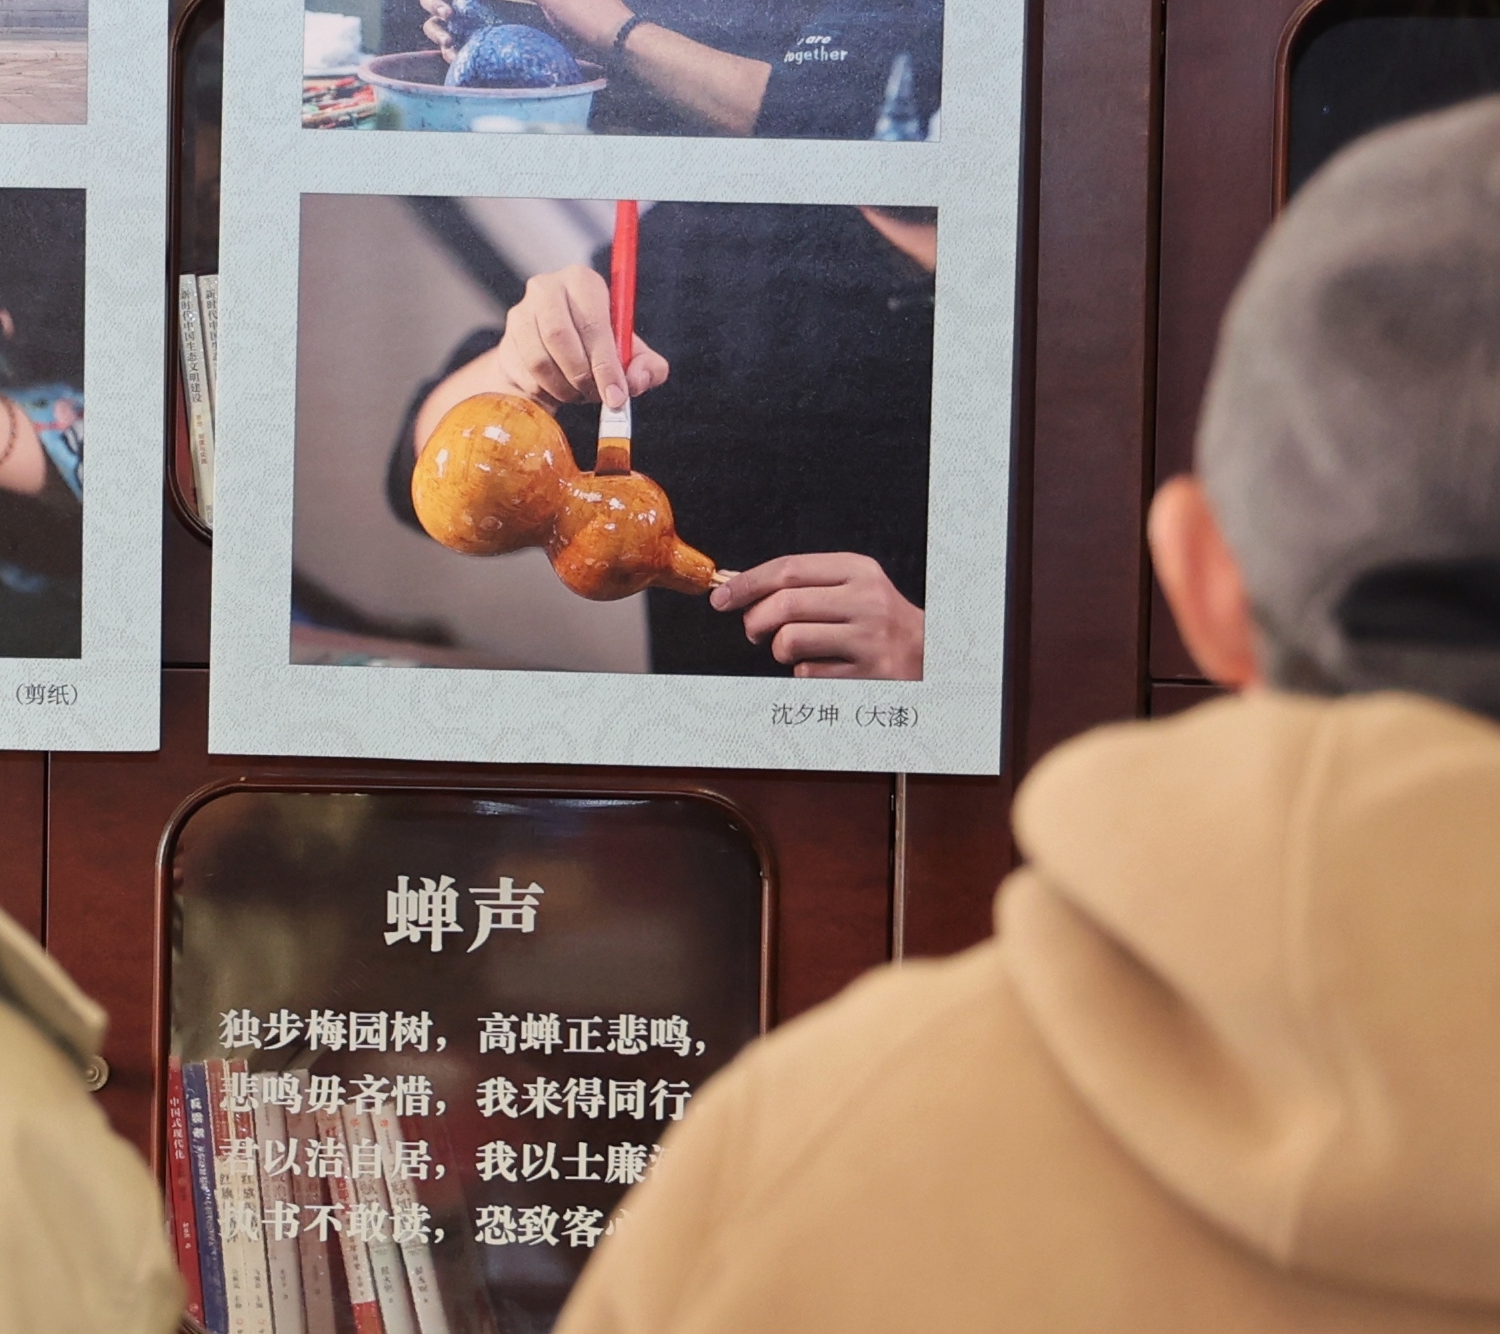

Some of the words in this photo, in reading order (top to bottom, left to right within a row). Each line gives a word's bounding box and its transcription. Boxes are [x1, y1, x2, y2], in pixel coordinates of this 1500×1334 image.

[180, 289, 203, 404] 新时代中国生态文明建设
[771, 702, 919, 729] 沈夕坤（大漆）
[382, 874, 545, 954] 蝉声
[218, 1008, 708, 1058] 独步梅园树，高蝉正悲鸣，
[218, 1140, 667, 1185] 君以洁自居，我以士廉
